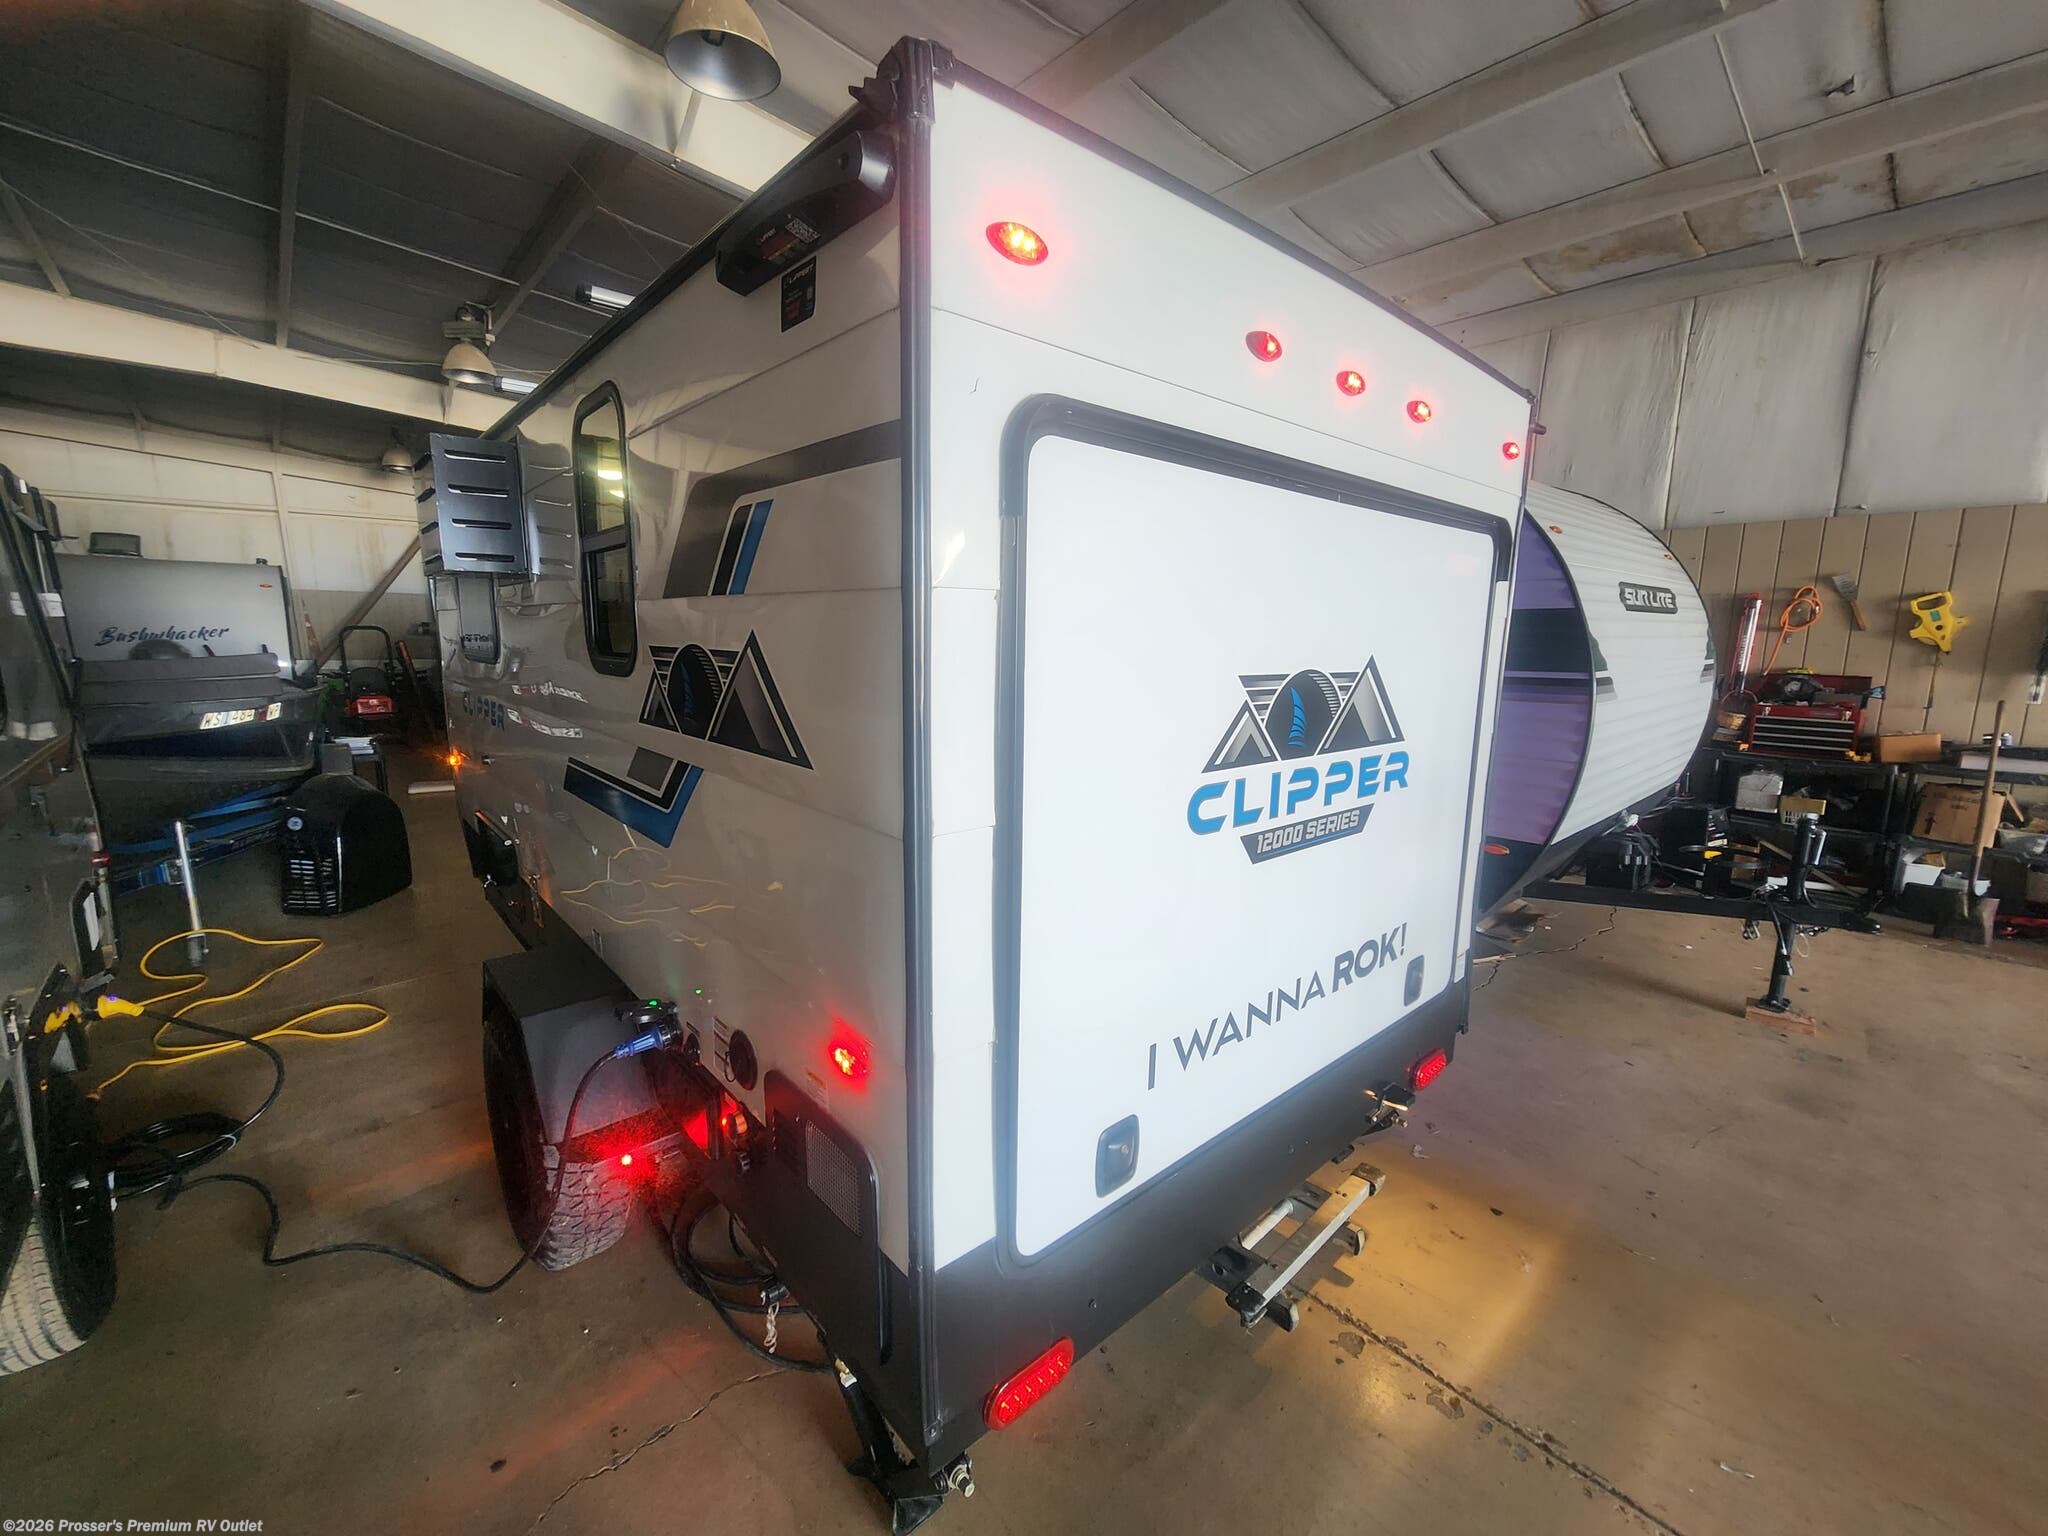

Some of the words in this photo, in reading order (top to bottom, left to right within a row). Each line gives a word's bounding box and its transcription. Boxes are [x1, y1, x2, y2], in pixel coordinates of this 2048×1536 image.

[95, 625, 230, 647] Bushwhacker
[1187, 750, 1410, 836] CLIPPER
[1256, 823, 1303, 854] 12000
[1305, 809, 1361, 840] SERIES
[1148, 1043, 1157, 1090] I
[1172, 969, 1326, 1072] WANNA
[1332, 922, 1408, 993] ROK!
